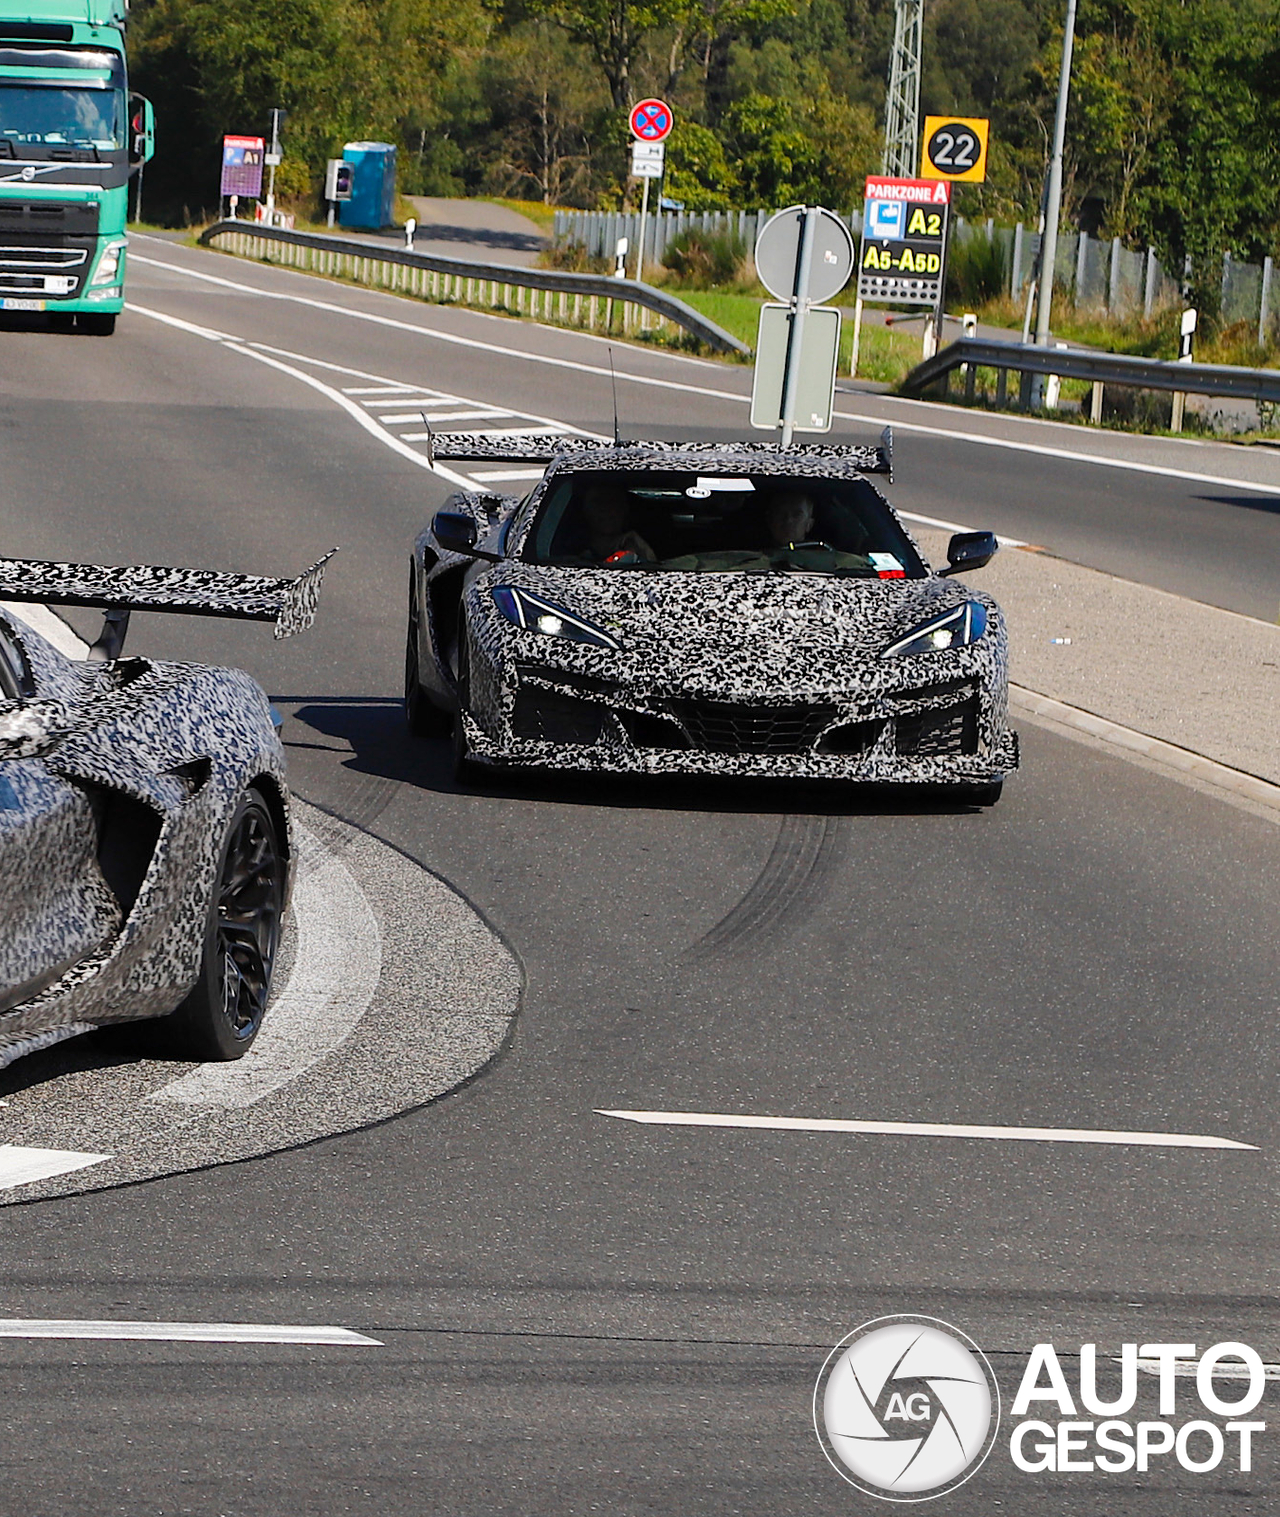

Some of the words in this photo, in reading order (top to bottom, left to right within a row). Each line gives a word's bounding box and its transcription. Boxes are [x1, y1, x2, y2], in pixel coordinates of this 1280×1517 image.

[243, 151, 259, 165] A1
[933, 132, 974, 167] 22
[866, 183, 932, 201] PARKZONE
[933, 182, 948, 203] A
[908, 208, 941, 236] A2
[863, 246, 940, 273] A5-A5D
